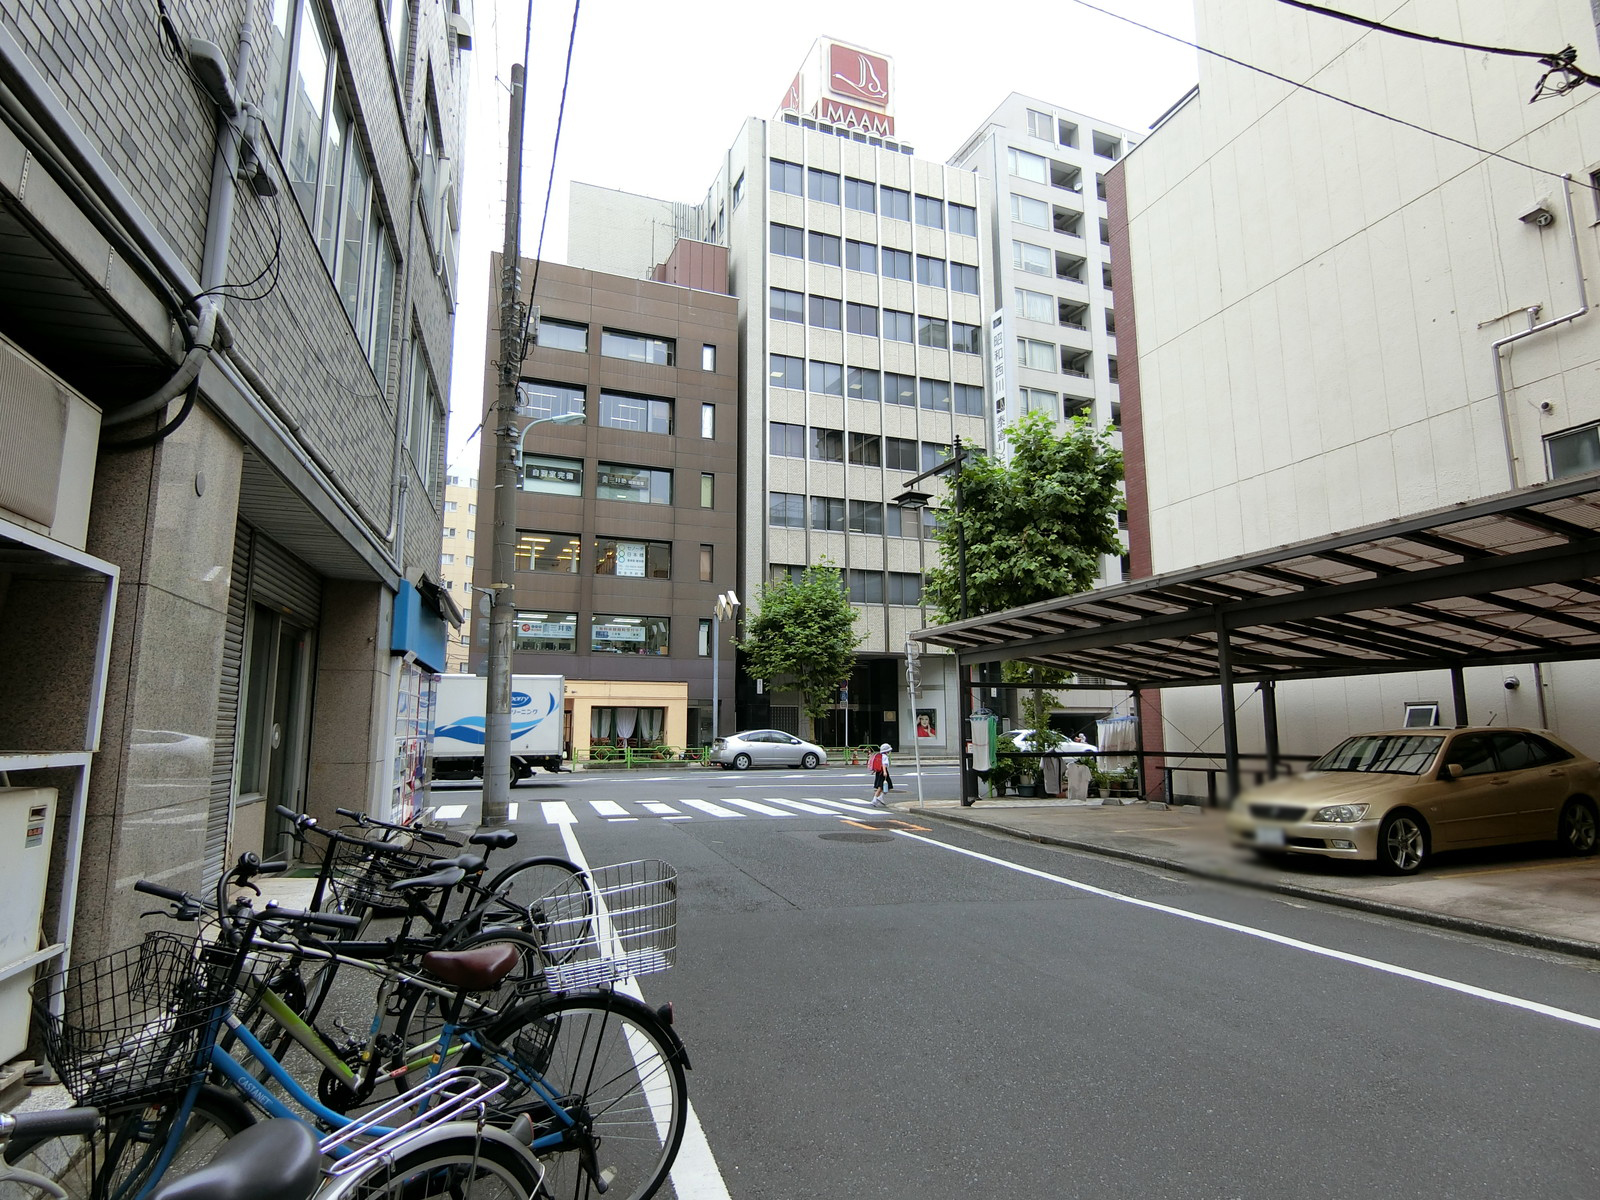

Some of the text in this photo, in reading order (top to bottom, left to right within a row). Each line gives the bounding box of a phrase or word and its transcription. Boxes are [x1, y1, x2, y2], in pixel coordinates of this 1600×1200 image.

[827, 102, 890, 137] MAAM
[993, 332, 1005, 394] 昭和西川
[238, 1076, 274, 1105] CASTANET
